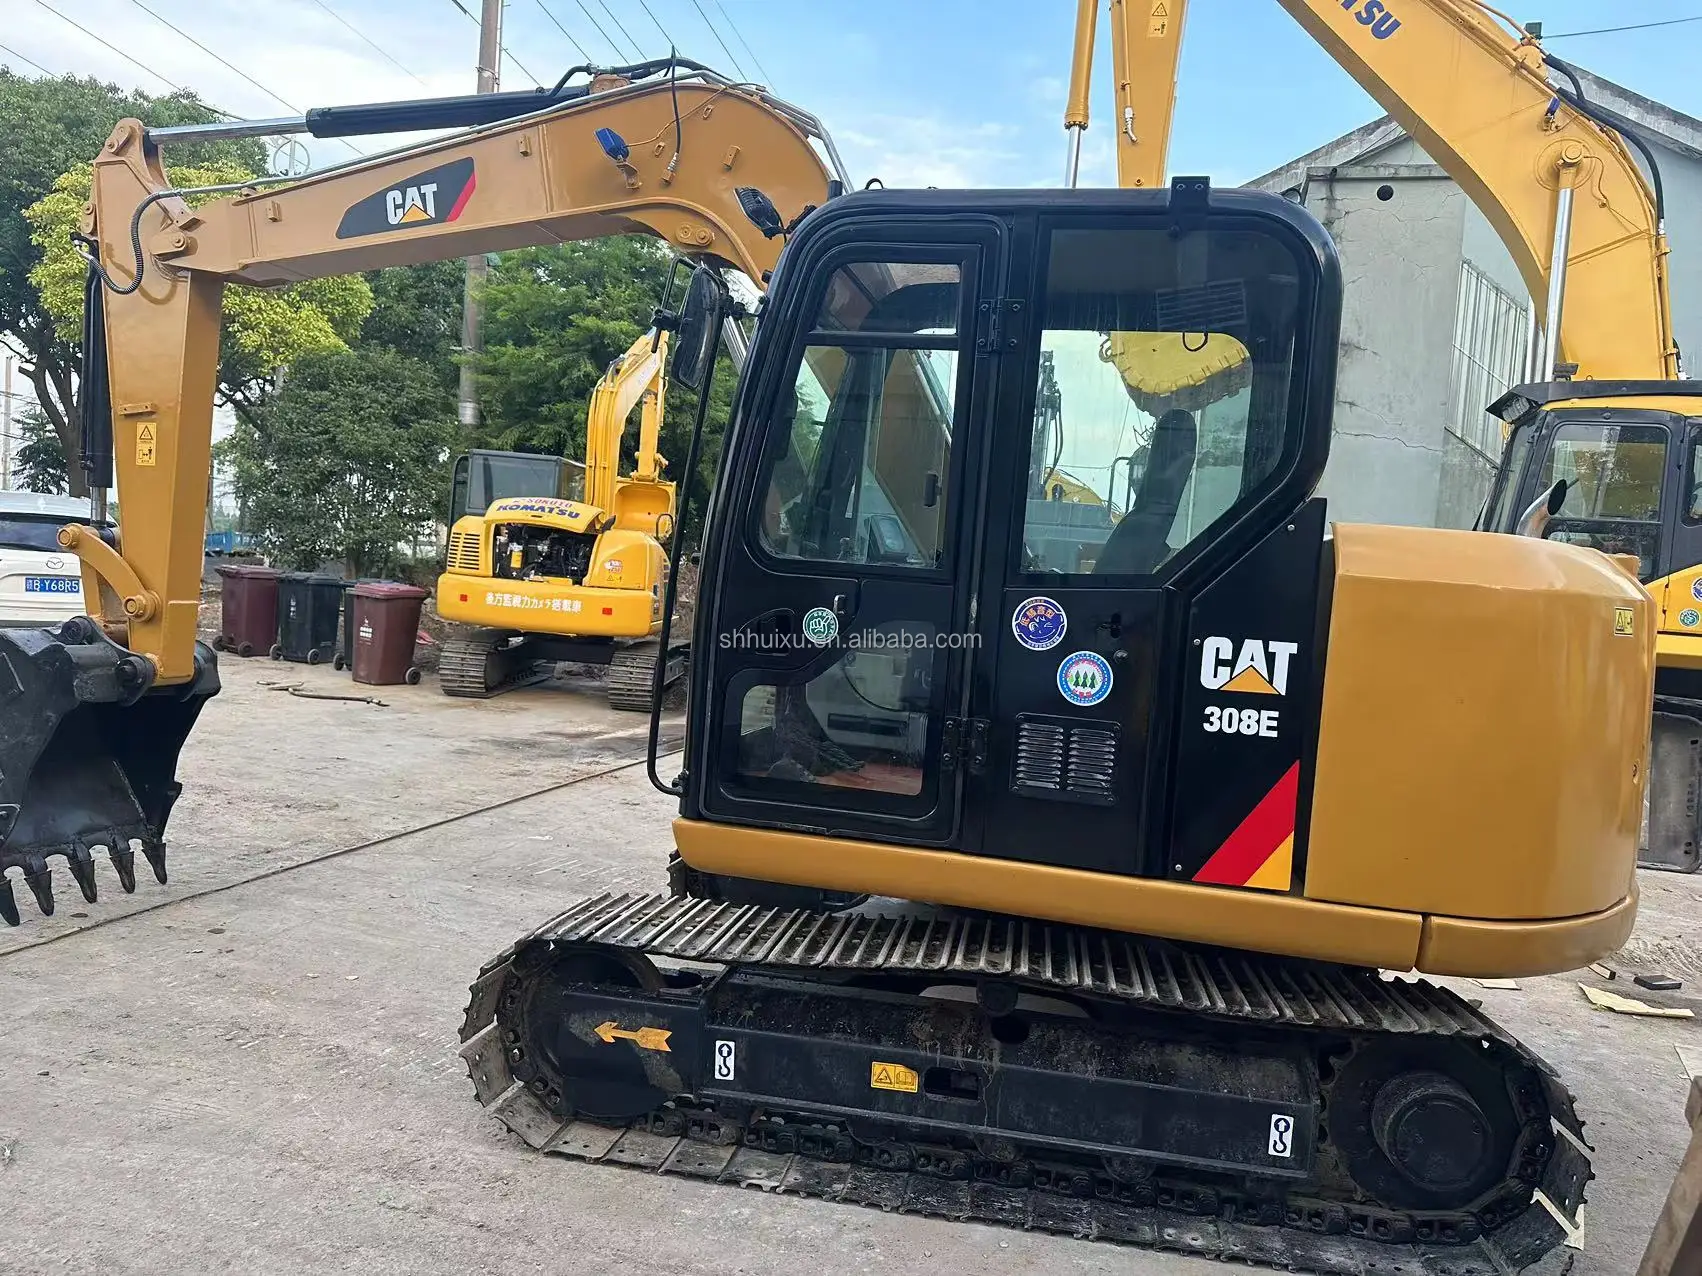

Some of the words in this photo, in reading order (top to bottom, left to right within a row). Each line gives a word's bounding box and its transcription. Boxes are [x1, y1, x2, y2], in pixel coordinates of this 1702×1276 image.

[1341, 0, 1402, 40] SU
[385, 183, 438, 225] CAT
[496, 504, 580, 519] KOMATSU
[1200, 636, 1298, 696] CAT
[1203, 705, 1280, 738] 308E
